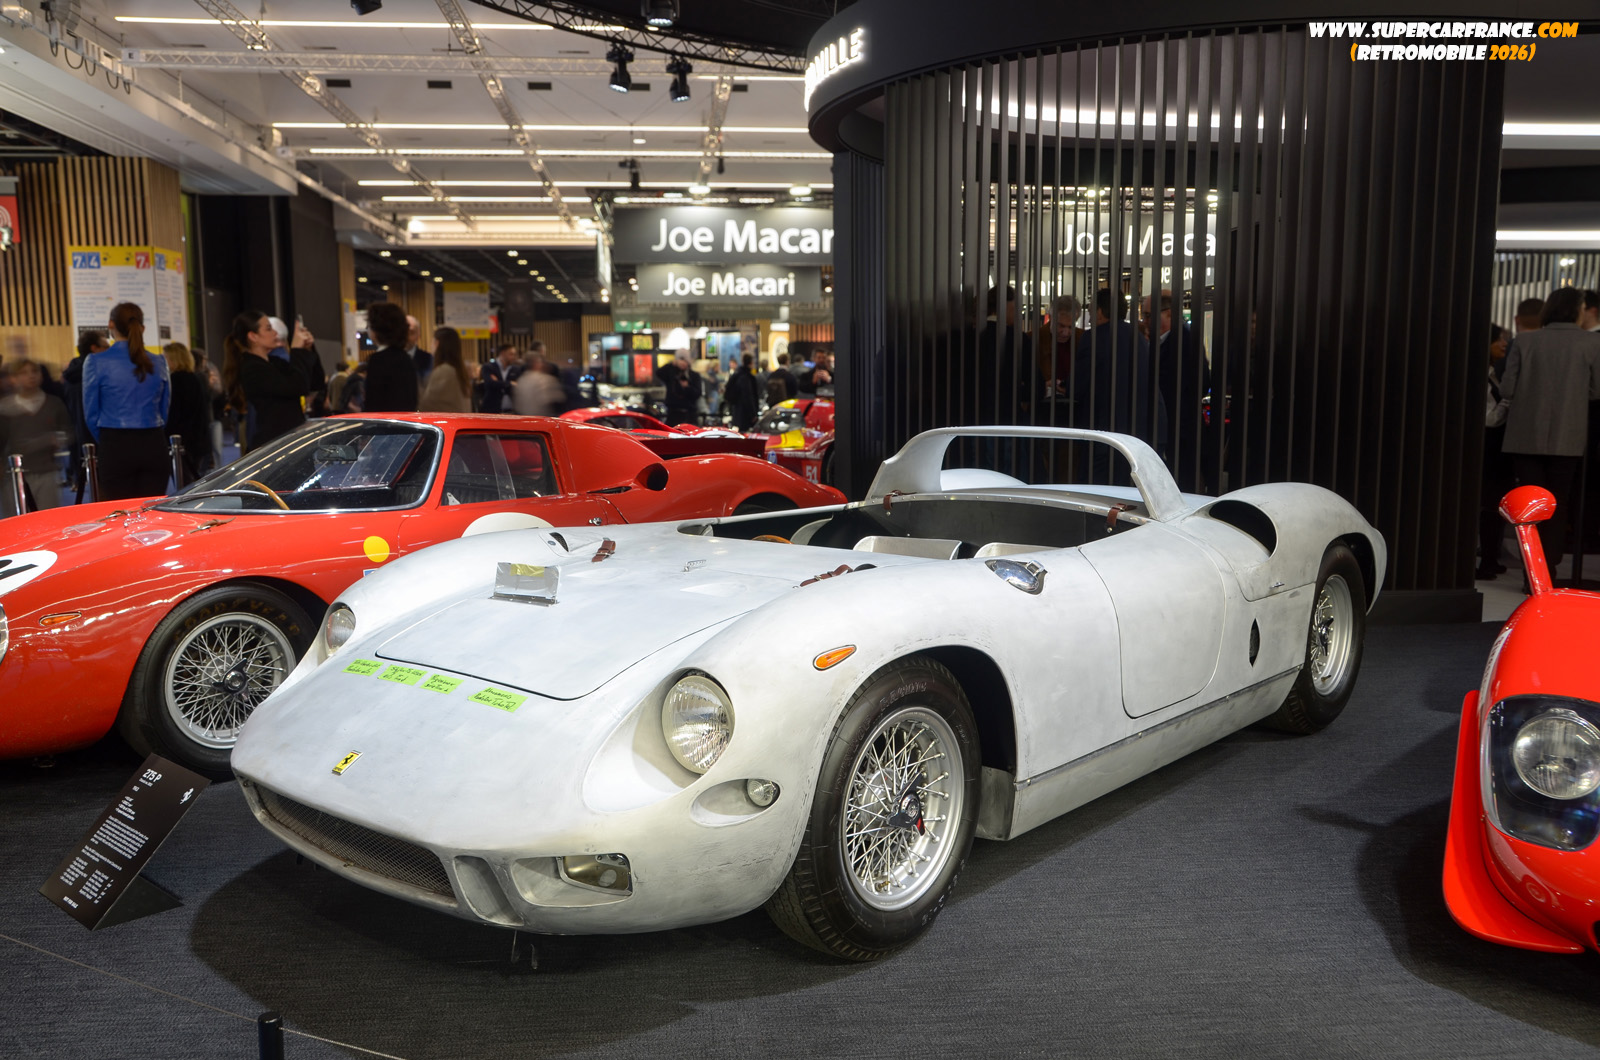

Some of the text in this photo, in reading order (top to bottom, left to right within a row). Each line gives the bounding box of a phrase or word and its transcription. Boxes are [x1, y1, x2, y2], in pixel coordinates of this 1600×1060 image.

[652, 218, 714, 252] Joe
[662, 271, 796, 297] Joe Macari
[142, 768, 158, 781] 275
[153, 773, 163, 783] P
